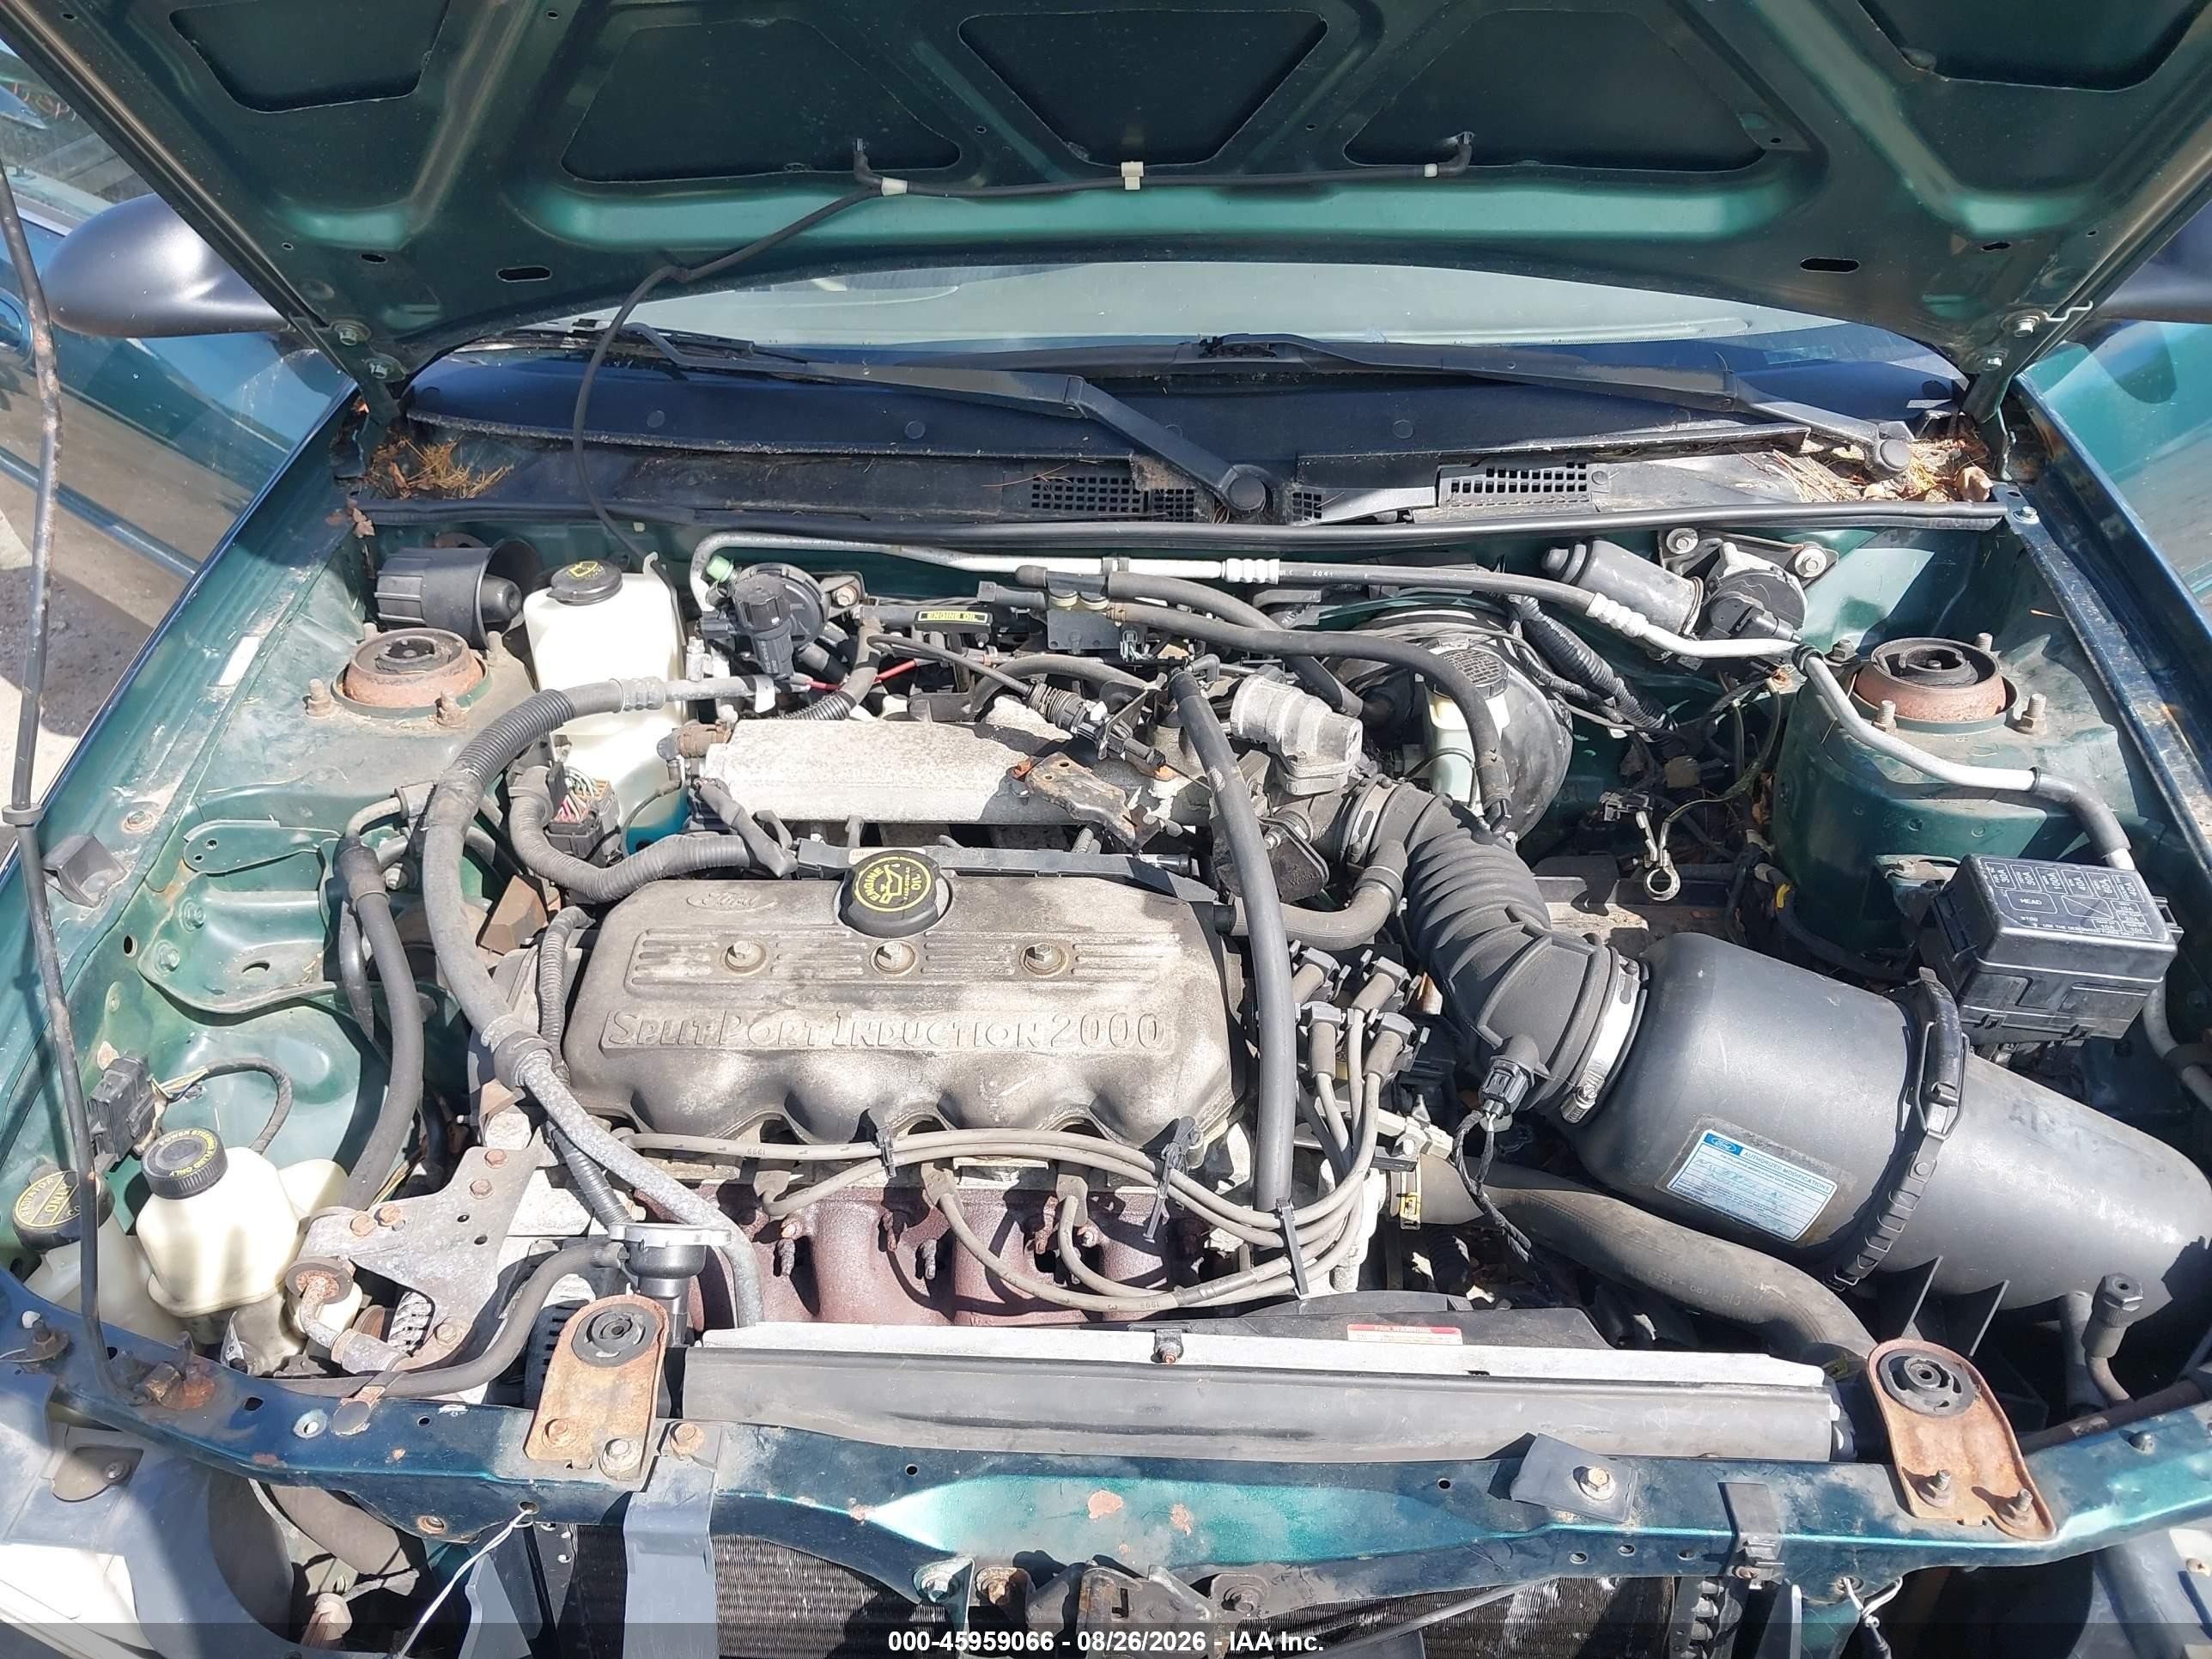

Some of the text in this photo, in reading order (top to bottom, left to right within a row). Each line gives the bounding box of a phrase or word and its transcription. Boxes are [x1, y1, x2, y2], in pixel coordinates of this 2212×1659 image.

[963, 612, 977, 621] OIL
[863, 866, 923, 902] ENGINE OIL
[1997, 869, 2010, 884] 30A
[2021, 872, 2036, 886] 30A
[2046, 872, 2063, 890] 100A
[2073, 877, 2087, 891] 40A
[2124, 882, 2137, 896] 40A
[718, 1010, 824, 1046] PORT
[831, 1011, 1039, 1048] INDUCTION
[1050, 1012, 1165, 1049] 2000
[159, 1129, 190, 1146] POWER
[169, 1166, 193, 1177] ONLY
[1744, 1151, 1783, 1172] AUTHORIZED
[1782, 1166, 1831, 1192] MODIFICATIONS
[19, 1177, 55, 1217] RADIATOR
[45, 1180, 73, 1213] ONLY
[1392, 1325, 1431, 1334] WARNING
